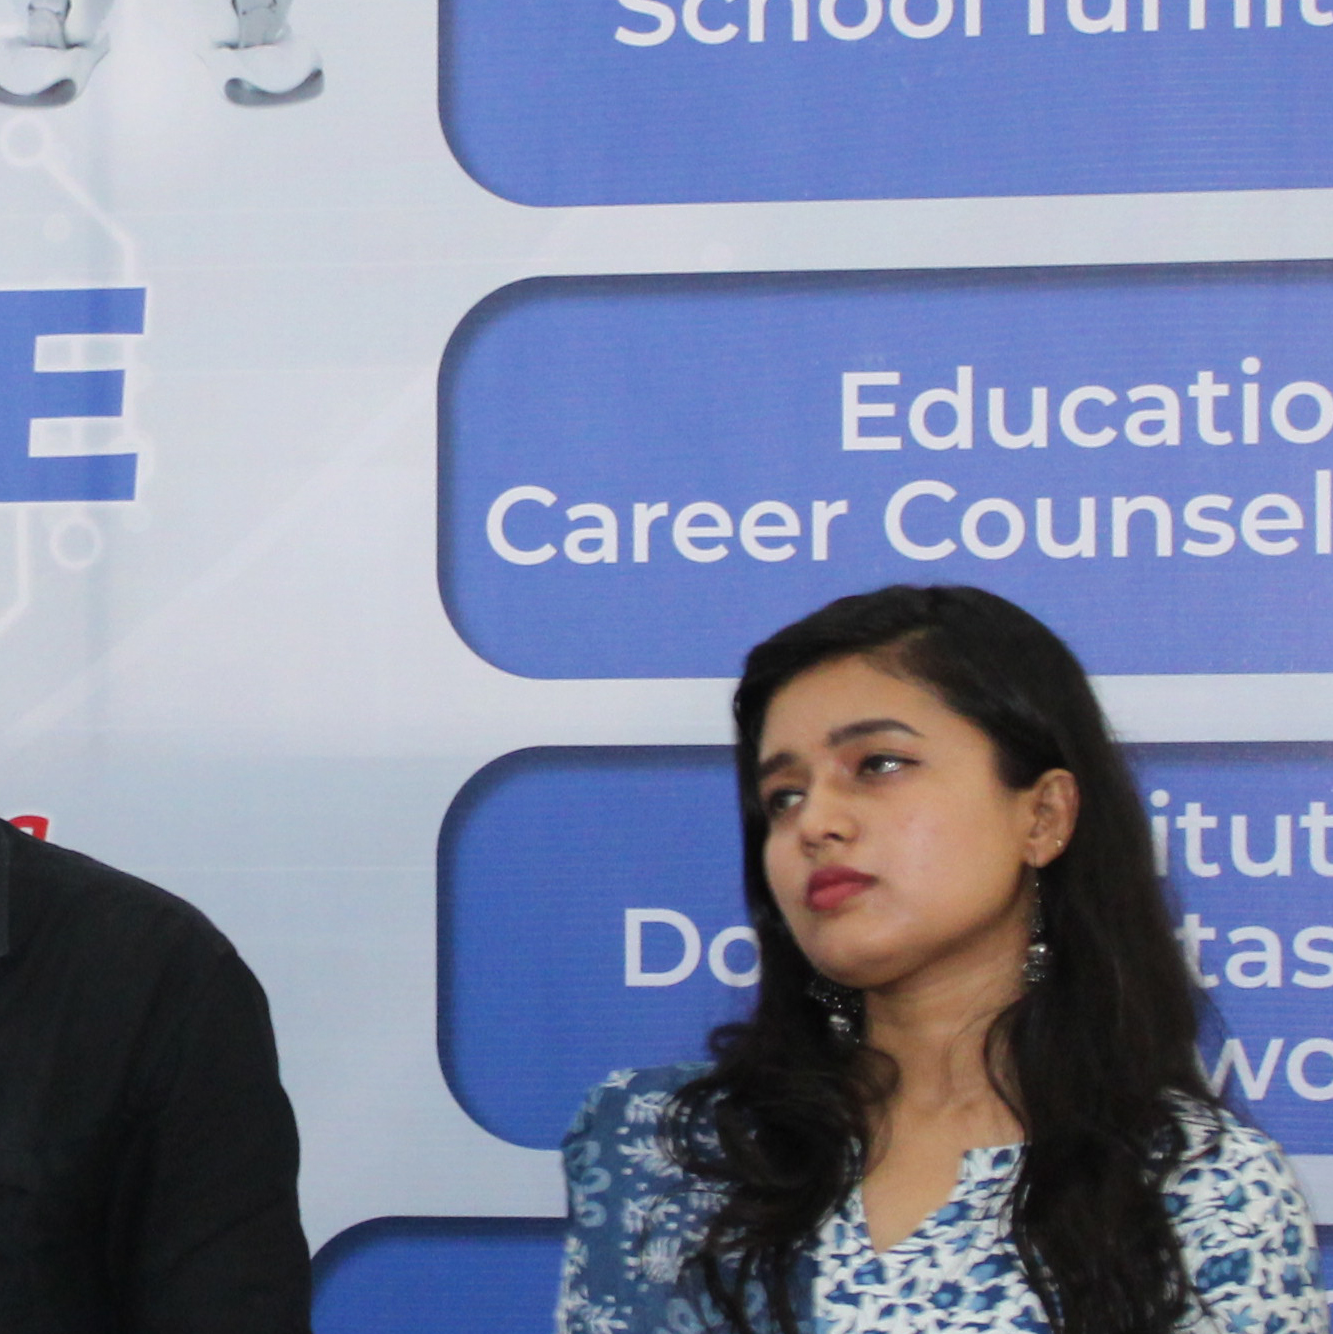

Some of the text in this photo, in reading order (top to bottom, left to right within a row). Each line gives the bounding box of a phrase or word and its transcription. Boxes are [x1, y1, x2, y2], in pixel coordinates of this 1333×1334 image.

[842, 356, 1333, 451] Educatio
[486, 469, 1333, 566] Career Counsel
